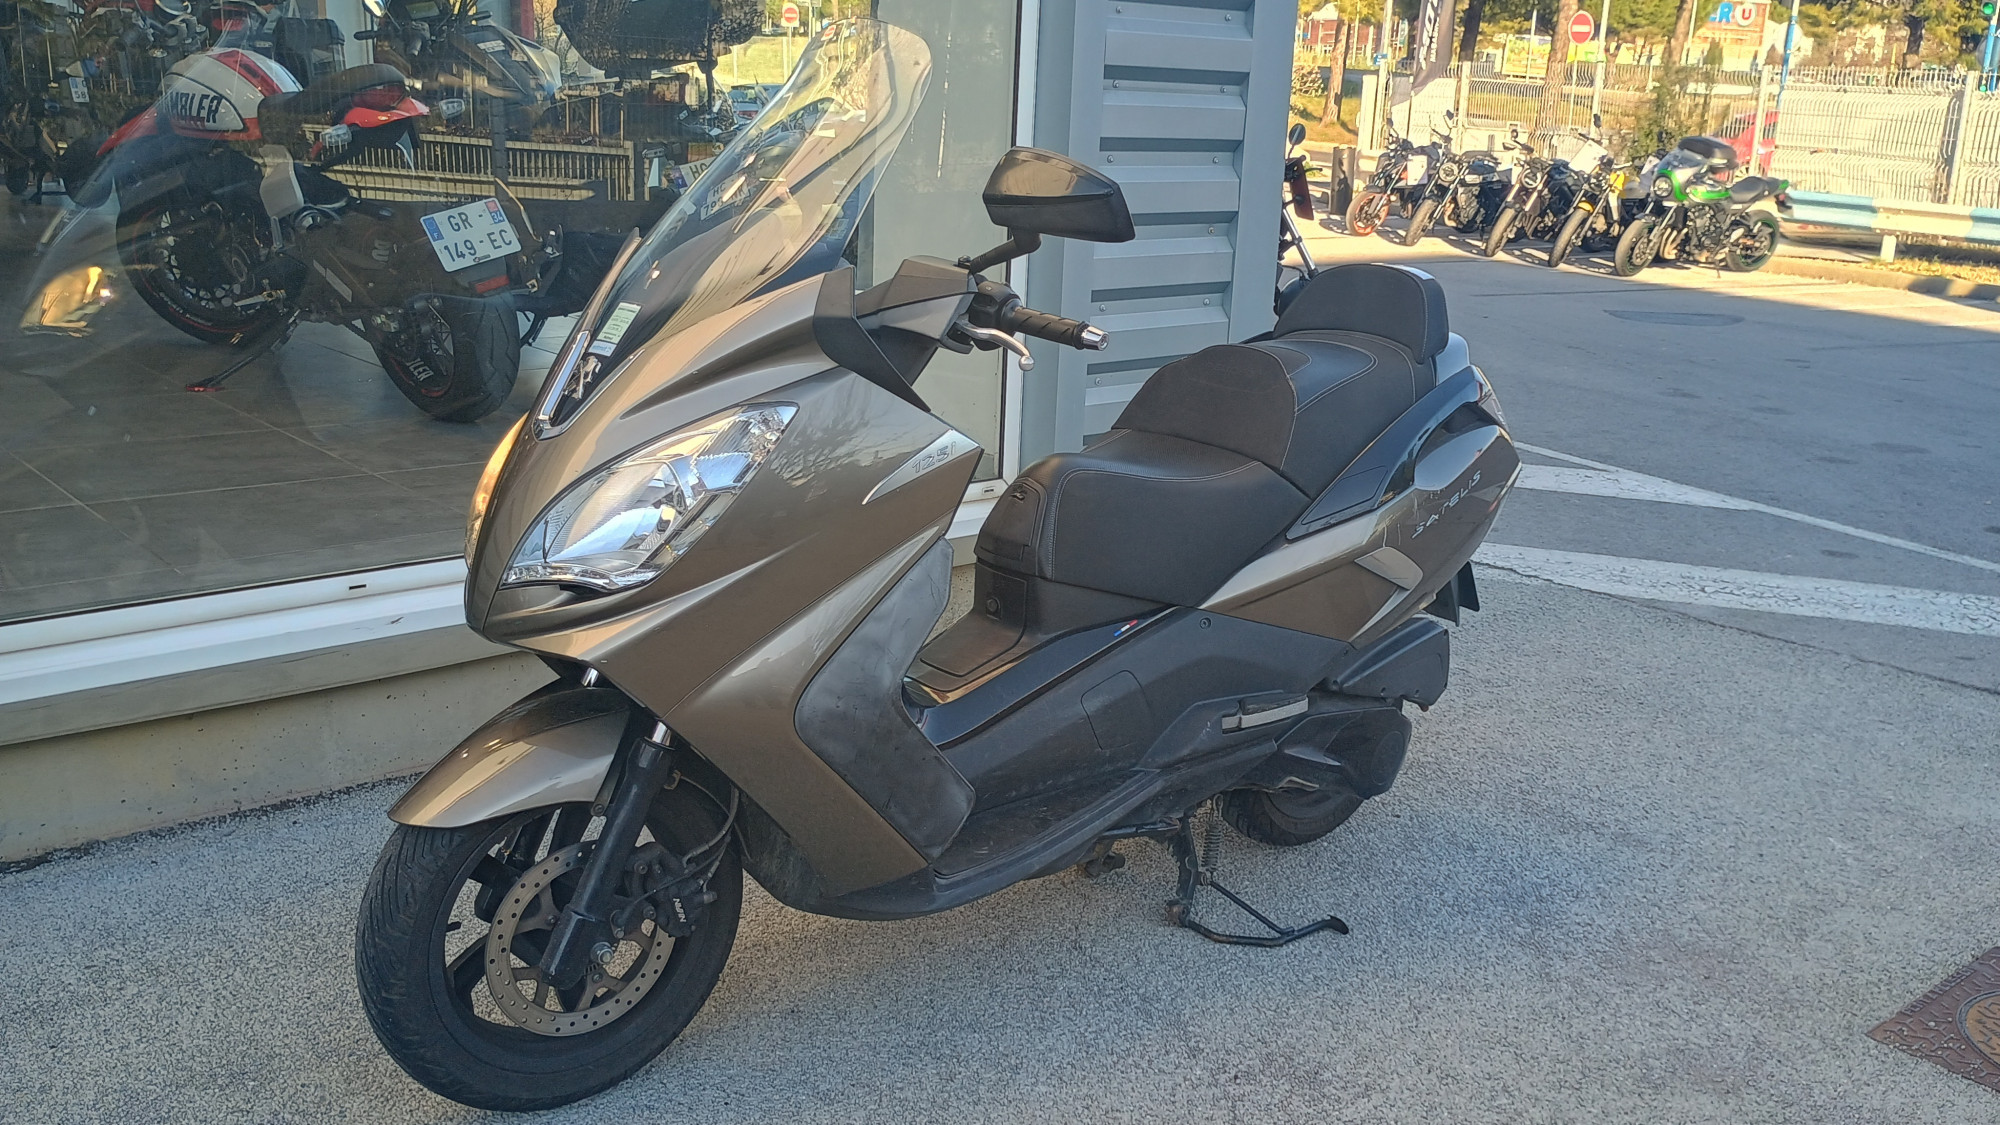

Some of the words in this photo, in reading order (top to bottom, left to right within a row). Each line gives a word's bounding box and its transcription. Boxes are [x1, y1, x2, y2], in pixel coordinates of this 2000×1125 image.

[491, 212, 504, 223] 34
[912, 441, 956, 474] 125i
[1411, 470, 1481, 539] SATELIS
